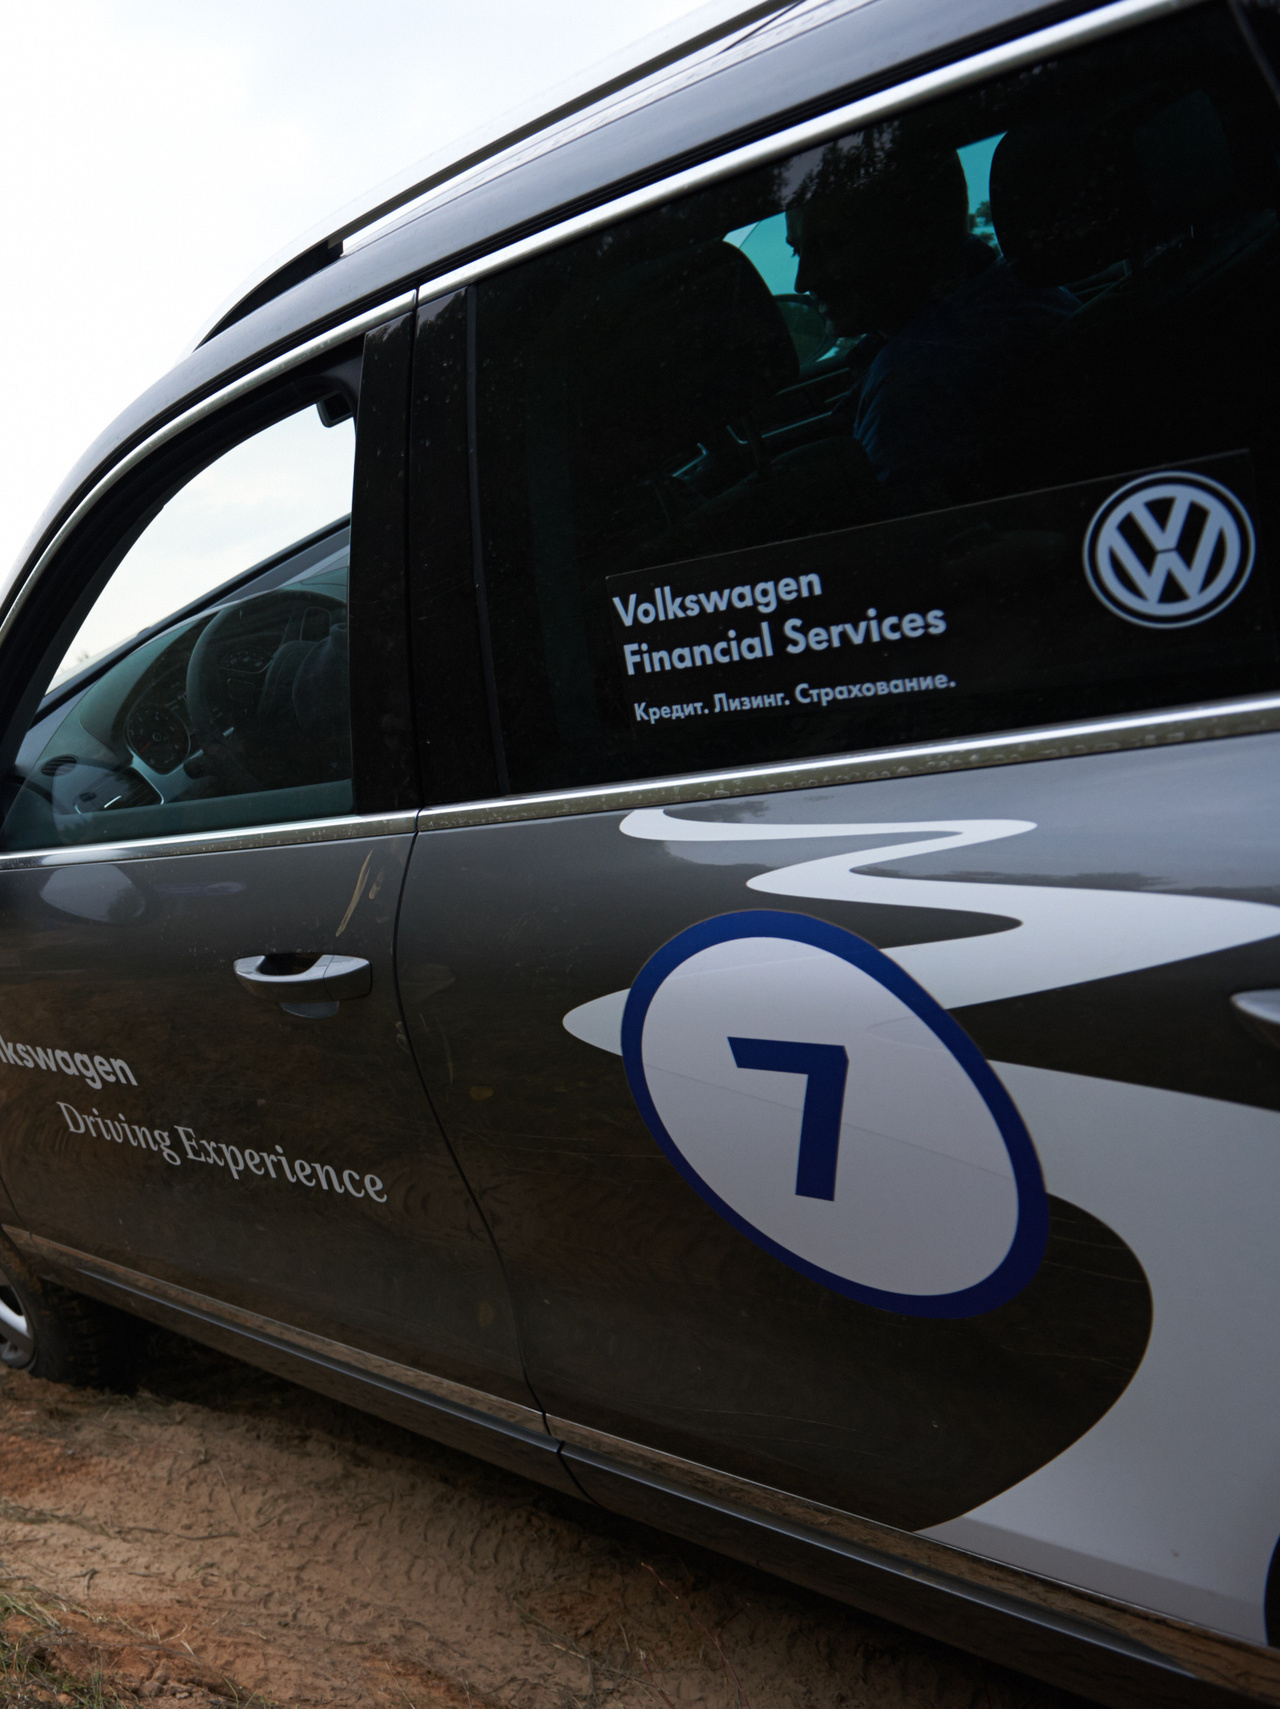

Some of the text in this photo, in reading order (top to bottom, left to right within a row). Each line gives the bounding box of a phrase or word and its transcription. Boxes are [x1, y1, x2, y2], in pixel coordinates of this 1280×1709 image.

[612, 573, 822, 627] Volkswagen
[623, 608, 947, 676] Financial Services
[633, 674, 957, 724] Кредит. Лизинг. Страхование.
[56, 1101, 388, 1203] Driving Experience
[726, 1036, 850, 1202] 7
